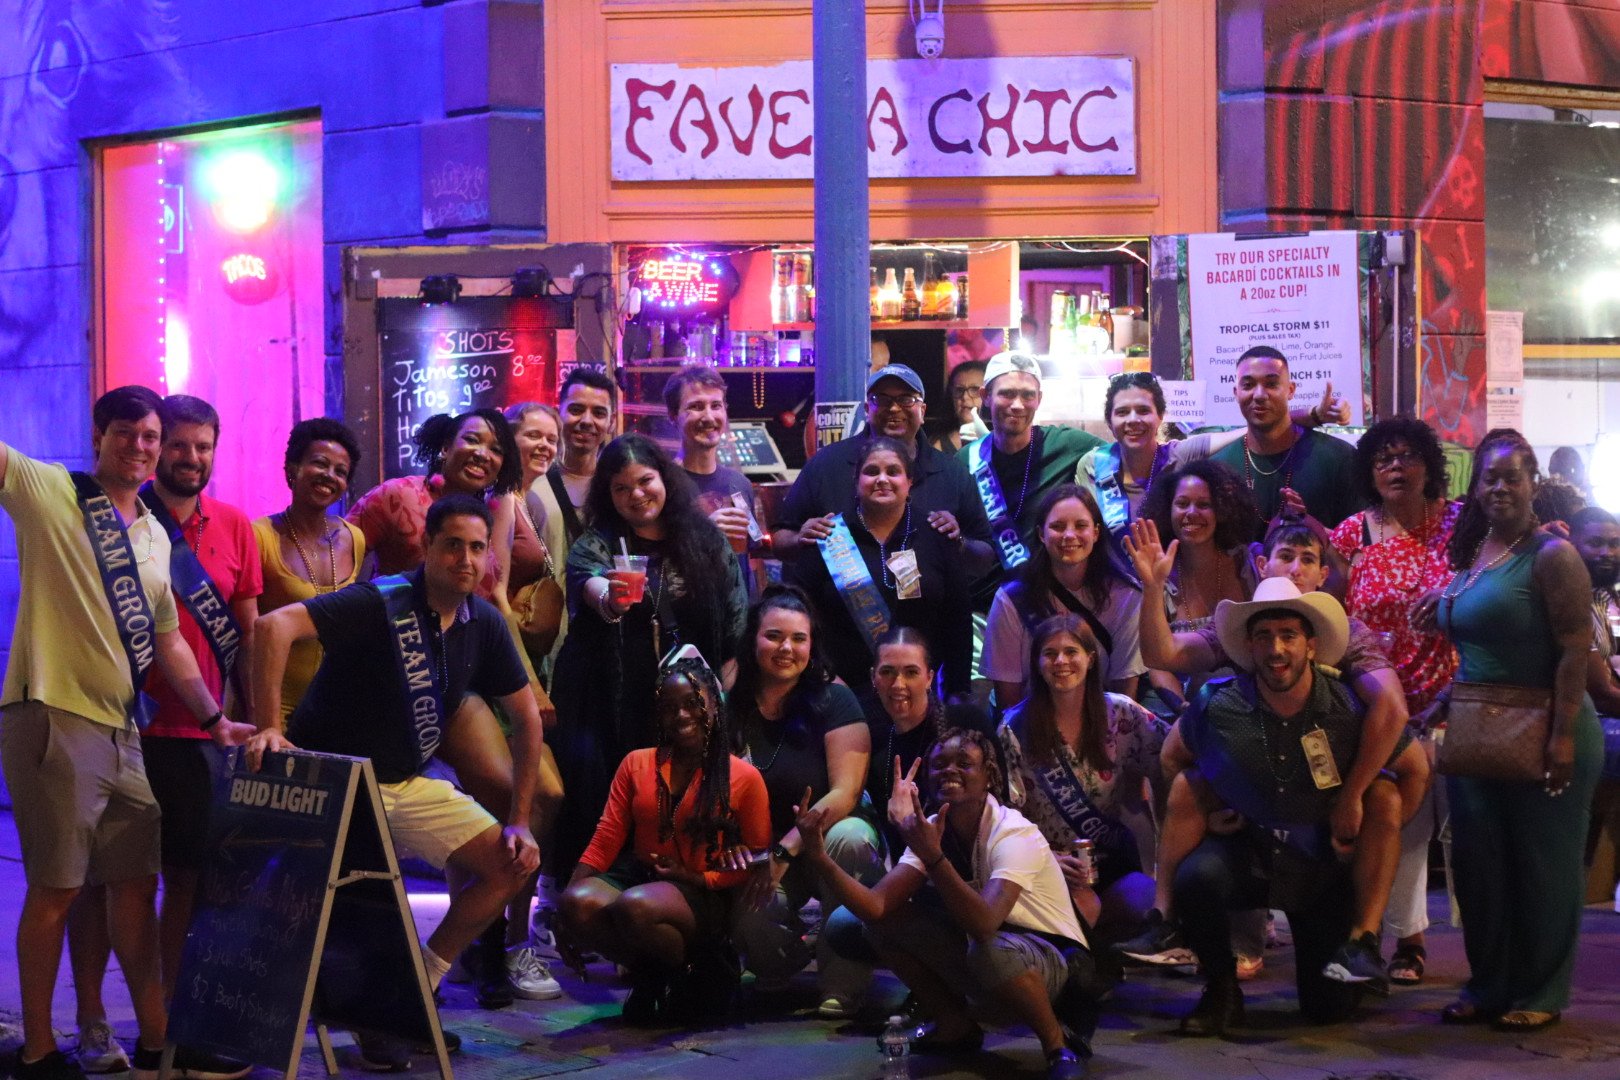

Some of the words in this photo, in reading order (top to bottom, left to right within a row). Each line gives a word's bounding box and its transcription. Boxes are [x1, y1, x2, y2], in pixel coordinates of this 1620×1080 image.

[625, 77, 908, 166] FAVEA
[928, 83, 1119, 158] CHIC
[1215, 252, 1236, 266] TRY
[1240, 250, 1264, 264] OUR
[1268, 246, 1330, 263] SPECIALTY
[643, 260, 702, 281] BEER
[1260, 264, 1324, 281] COCKTAILS
[1328, 264, 1340, 277] IN
[664, 281, 719, 302] WINE
[1240, 287, 1247, 301] A
[1251, 287, 1276, 300] 20oz
[1279, 284, 1307, 298] CUP!
[1219, 323, 1270, 335] TROPICAL
[1273, 321, 1310, 332] STORM
[1313, 320, 1330, 330] $11
[439, 330, 515, 354] SHOTS
[1319, 352, 1343, 361] Juices
[393, 360, 497, 386] Jameson
[1290, 371, 1312, 380] NCH
[1316, 370, 1332, 379] $11
[1294, 391, 1320, 400] eapple
[975, 461, 1006, 527] TEAM
[86, 491, 131, 573] TEAM
[112, 575, 153, 675] GROOM
[189, 580, 240, 655] TEAM
[393, 610, 433, 694] TEAM
[229, 778, 270, 807] BUD
[269, 786, 329, 816] LIGHT
[1043, 764, 1090, 819] EAM
